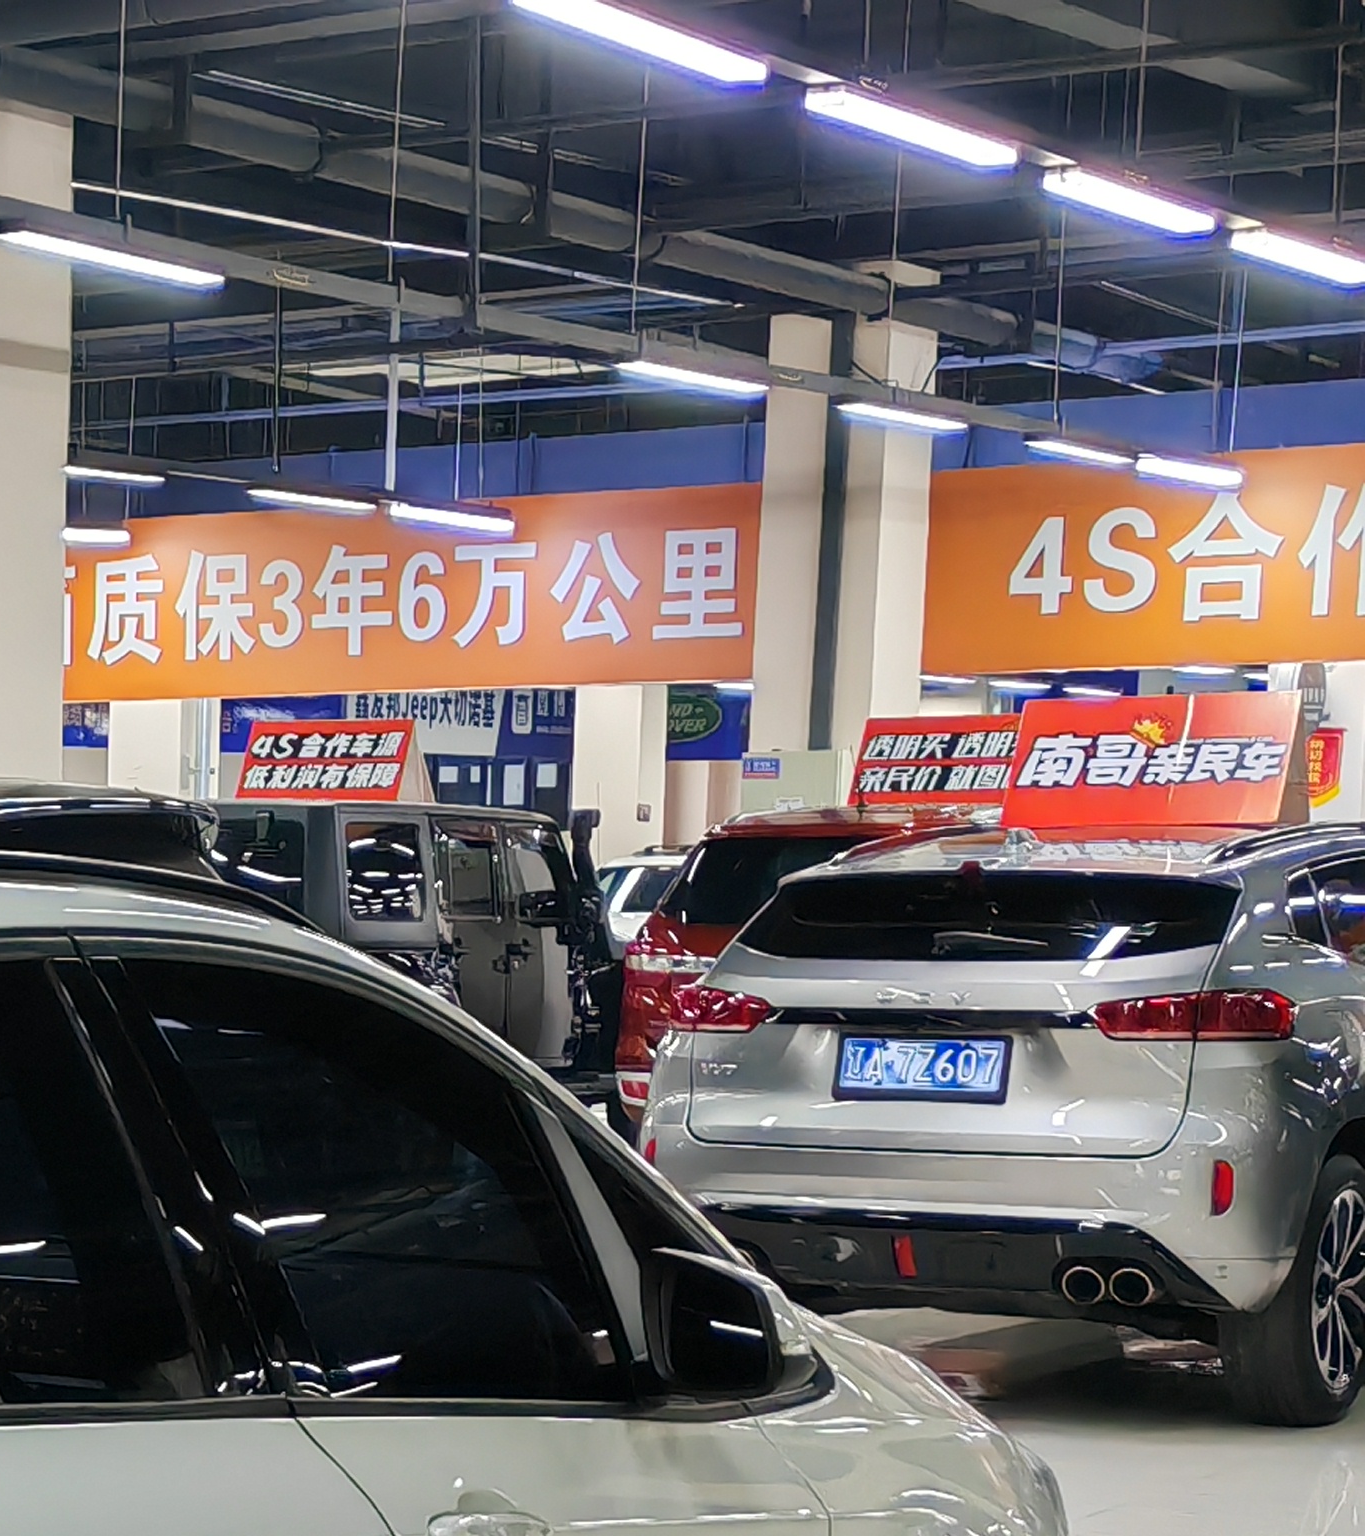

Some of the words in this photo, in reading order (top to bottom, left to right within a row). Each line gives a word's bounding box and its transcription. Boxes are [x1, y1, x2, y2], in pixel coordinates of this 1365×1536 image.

[63, 527, 745, 667] 质保3年6万公里
[862, 731, 953, 761] 透明买
[951, 730, 1019, 759] 透明
[243, 762, 401, 790] 低利润有保障
[858, 765, 943, 792] 亲民价
[943, 763, 1012, 790] 就图
